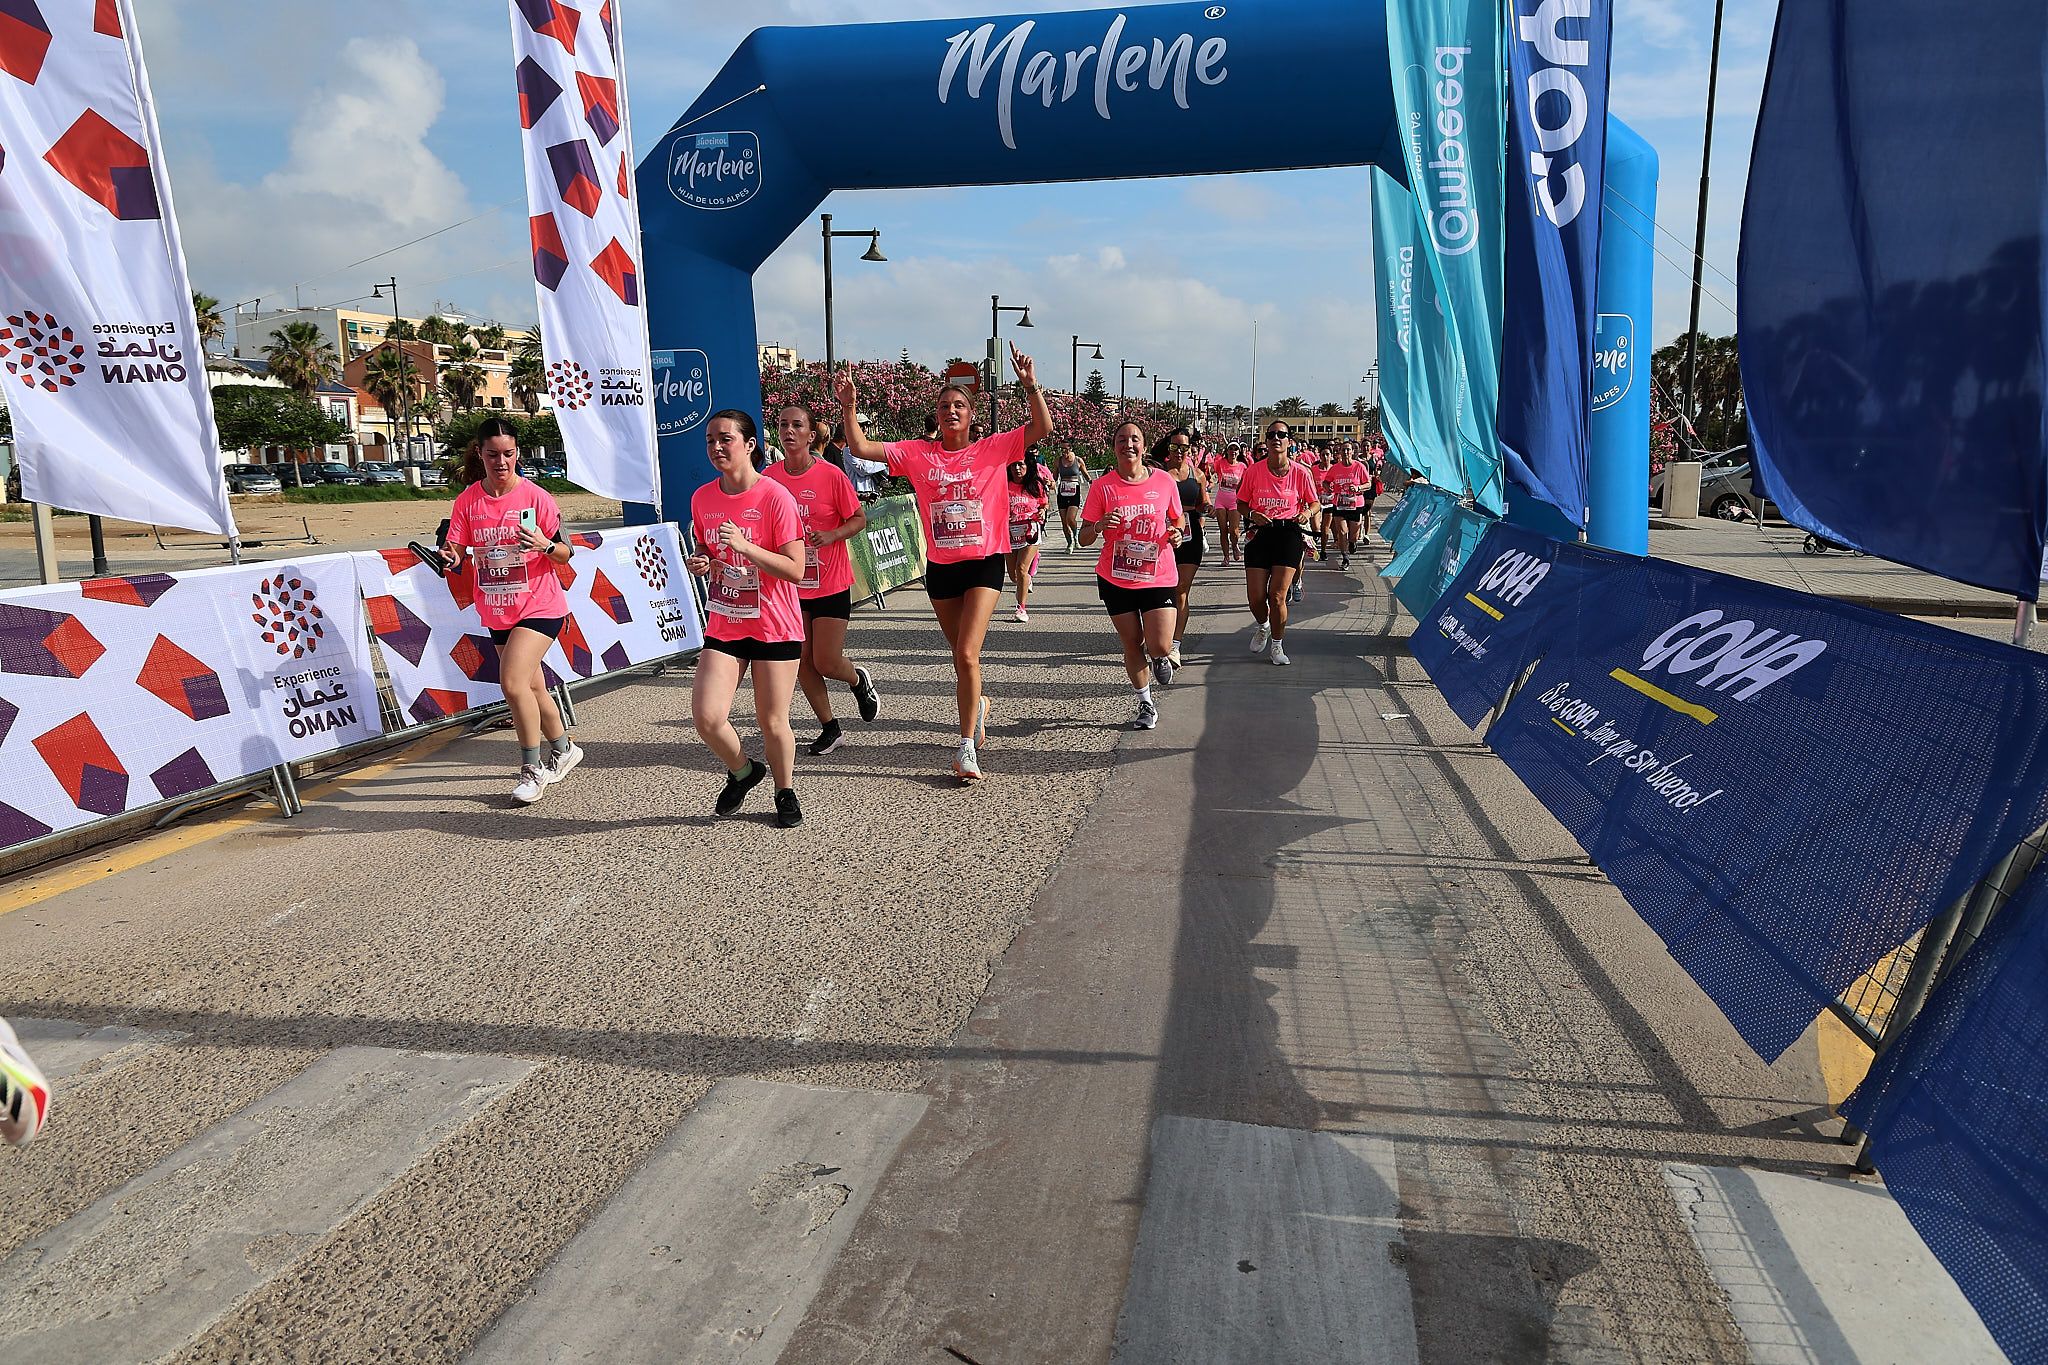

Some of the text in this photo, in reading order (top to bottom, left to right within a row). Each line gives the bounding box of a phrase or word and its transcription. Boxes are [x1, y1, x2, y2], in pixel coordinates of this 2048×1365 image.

[938, 13, 1228, 149] Marlene
[674, 149, 755, 189] Marlene
[677, 186, 694, 201] HIJA
[695, 196, 707, 205] DE
[726, 187, 750, 204] ALPES
[653, 368, 704, 405] rlene
[1593, 384, 1620, 405] ALPES
[674, 410, 699, 429] ALPES
[953, 483, 968, 500] DE
[1258, 497, 1288, 507] CARRERA
[947, 521, 967, 530] 016
[705, 527, 753, 544] CARA
[1126, 557, 1143, 567] 016
[489, 567, 510, 577] 016
[1476, 548, 1551, 607] GOYA
[722, 586, 740, 598] 016
[648, 597, 679, 610] Experience
[660, 624, 687, 643] OMAN
[1638, 609, 1827, 701] GOYA
[273, 666, 341, 689] Experience
[288, 704, 358, 739] OMAN
[1550, 696, 1566, 712] es
[1559, 698, 1600, 730] GOYA
[1587, 739, 1638, 766] que
[1646, 753, 1724, 814] bueno!
